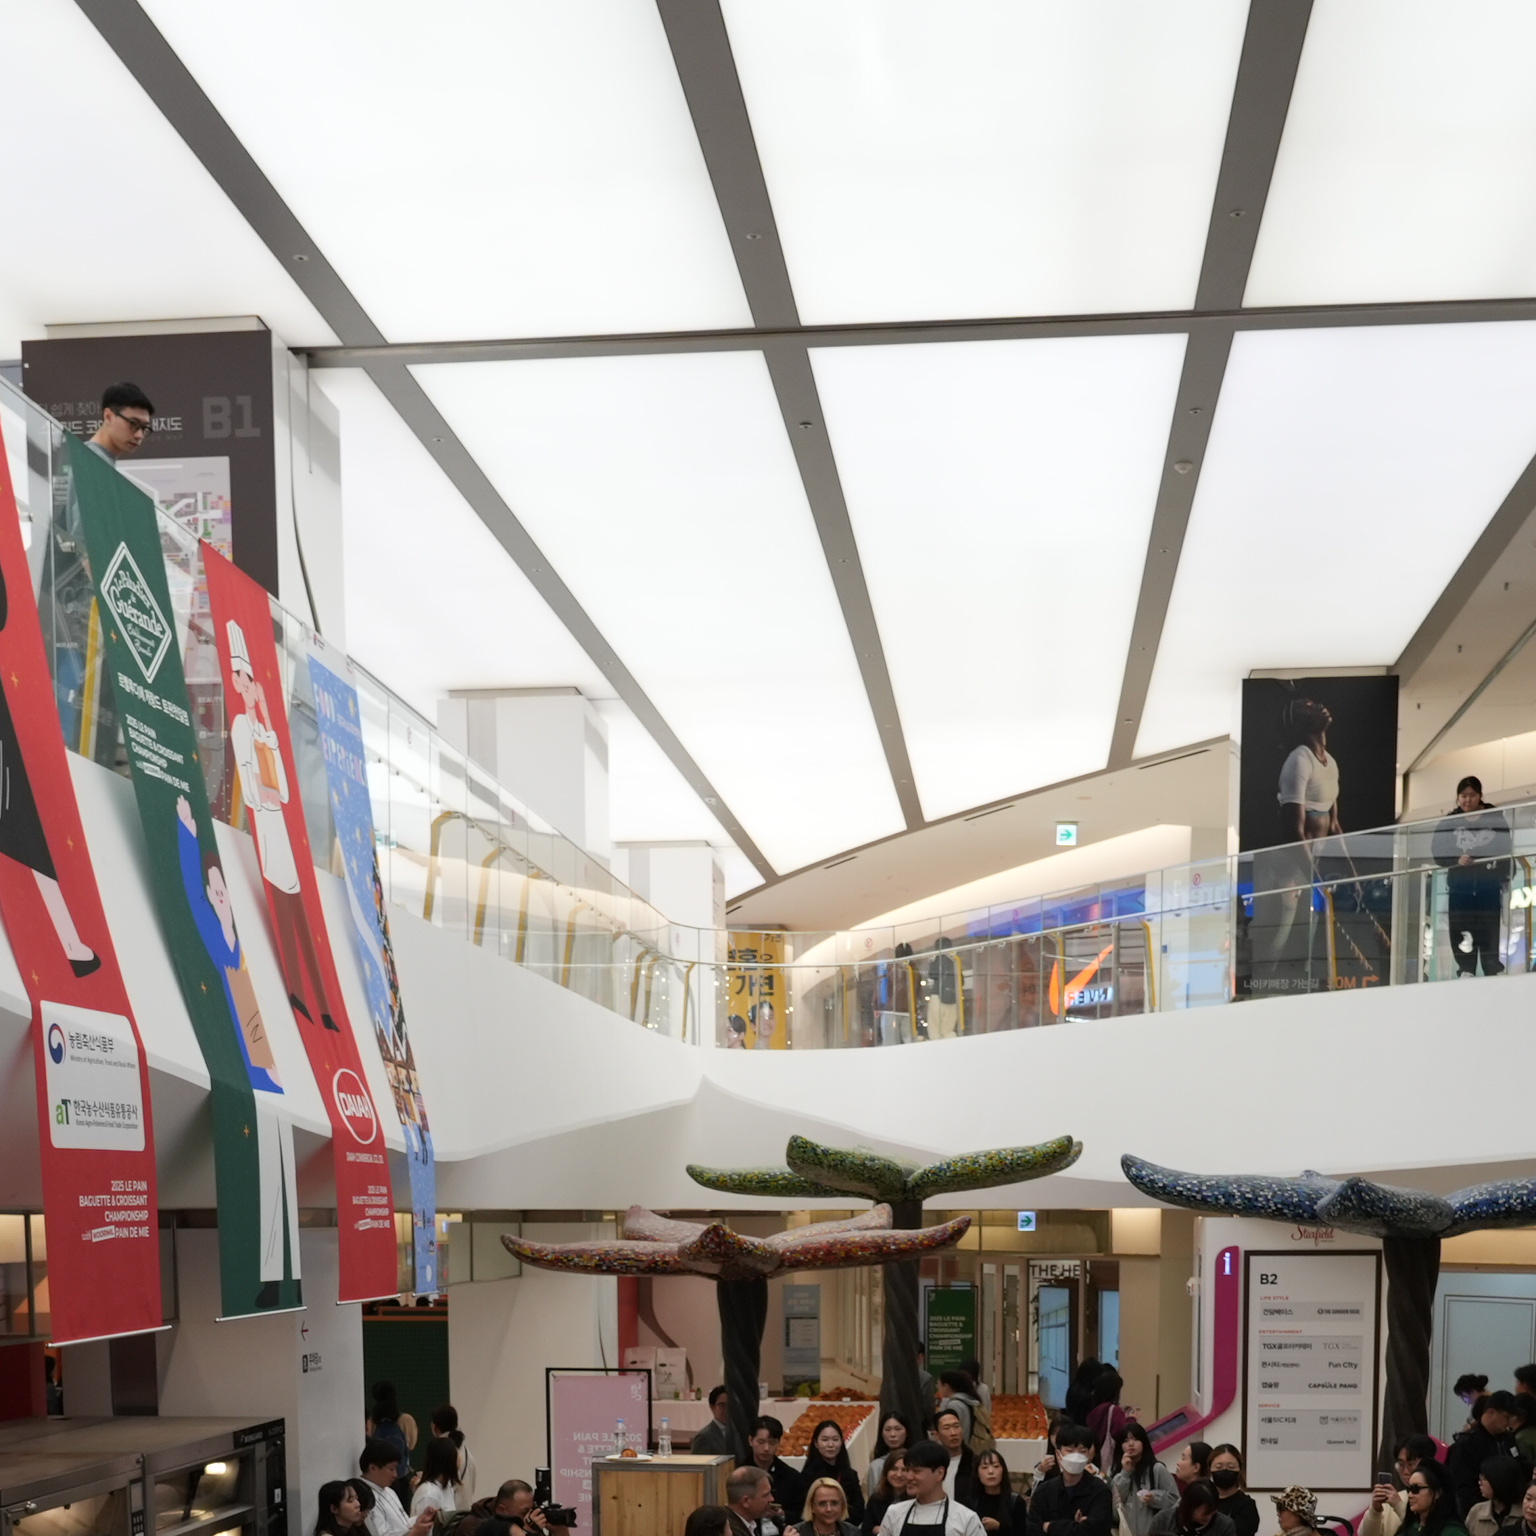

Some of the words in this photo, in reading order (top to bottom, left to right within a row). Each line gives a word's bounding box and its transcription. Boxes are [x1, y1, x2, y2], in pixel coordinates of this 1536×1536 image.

[202, 396, 261, 439] B1
[1244, 978, 1290, 990] 나이키매장
[69, 1031, 114, 1053] 농림축산식품부
[74, 1100, 138, 1120] 한국농수산식품유통공사
[111, 1180, 124, 1191] 2025
[125, 1181, 132, 1191] LE
[133, 1180, 147, 1191] PAIN
[79, 1195, 111, 1207] BAGUETTE
[116, 1195, 148, 1206] CROISSANT
[105, 1210, 149, 1222] CHAMPIONSHIP
[115, 1227, 129, 1238] PAIN
[130, 1227, 138, 1238] DE
[139, 1226, 149, 1237] MIE
[1291, 1224, 1335, 1247] Starfield
[1030, 1264, 1059, 1277] THE
[1260, 1274, 1278, 1285] B2
